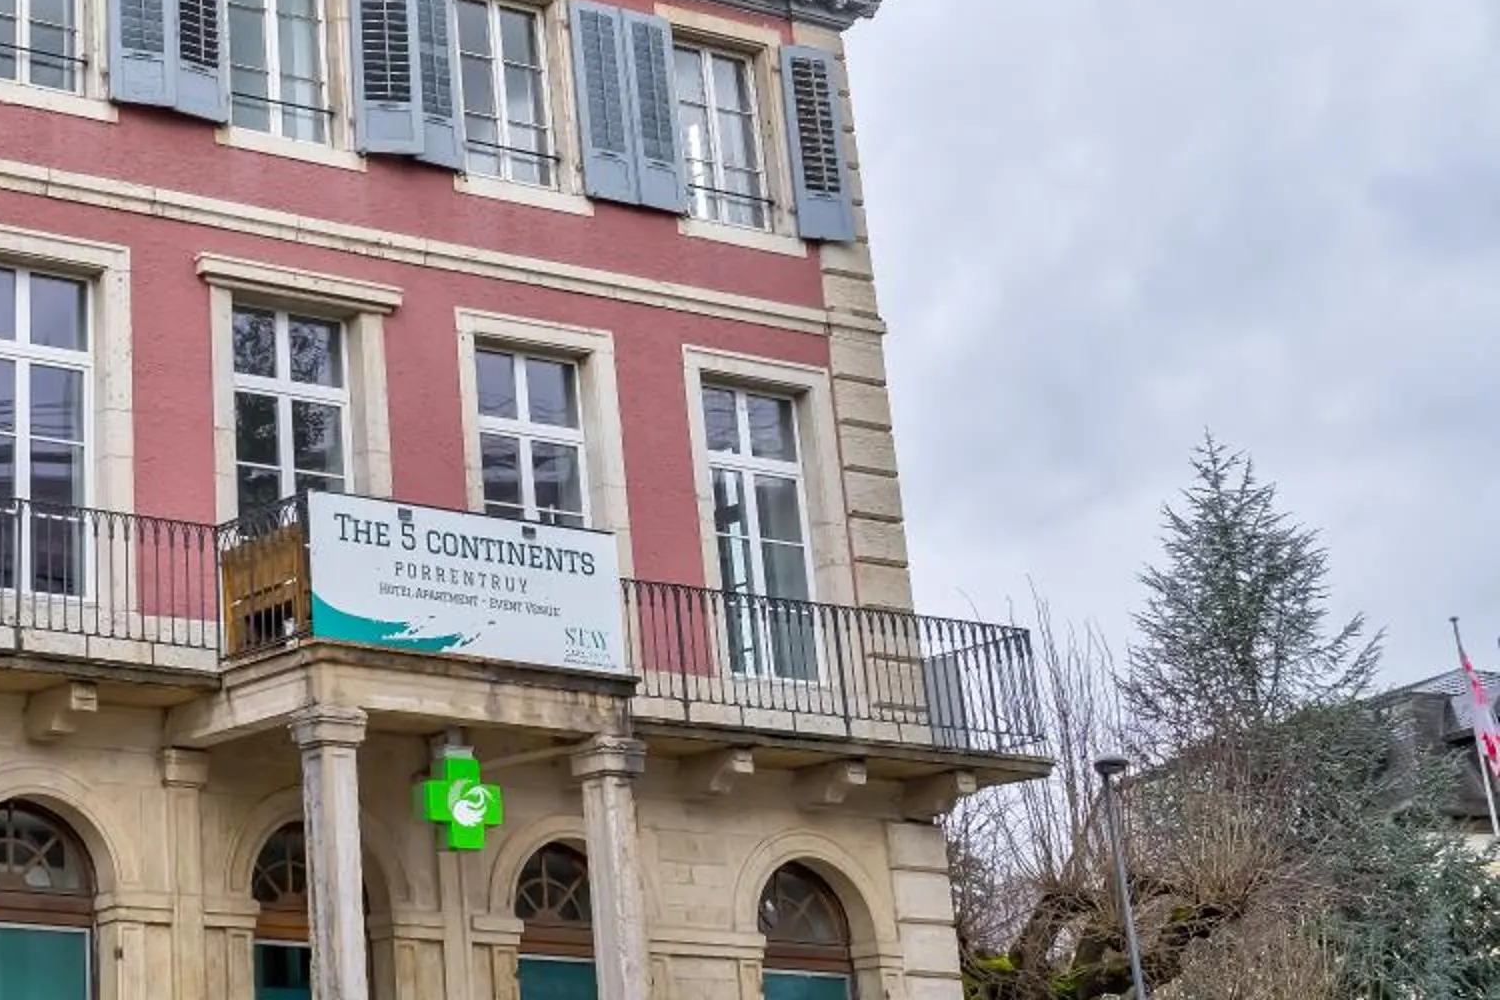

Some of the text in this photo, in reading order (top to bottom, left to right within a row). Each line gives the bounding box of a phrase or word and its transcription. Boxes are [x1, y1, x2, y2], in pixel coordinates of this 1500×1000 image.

[334, 513, 596, 575] THE 5 CONTINENTS
[395, 561, 528, 594] PORRENTRUY
[379, 581, 411, 597] HOTEL
[415, 586, 478, 607] APARTMENT
[489, 597, 522, 613] EVENT
